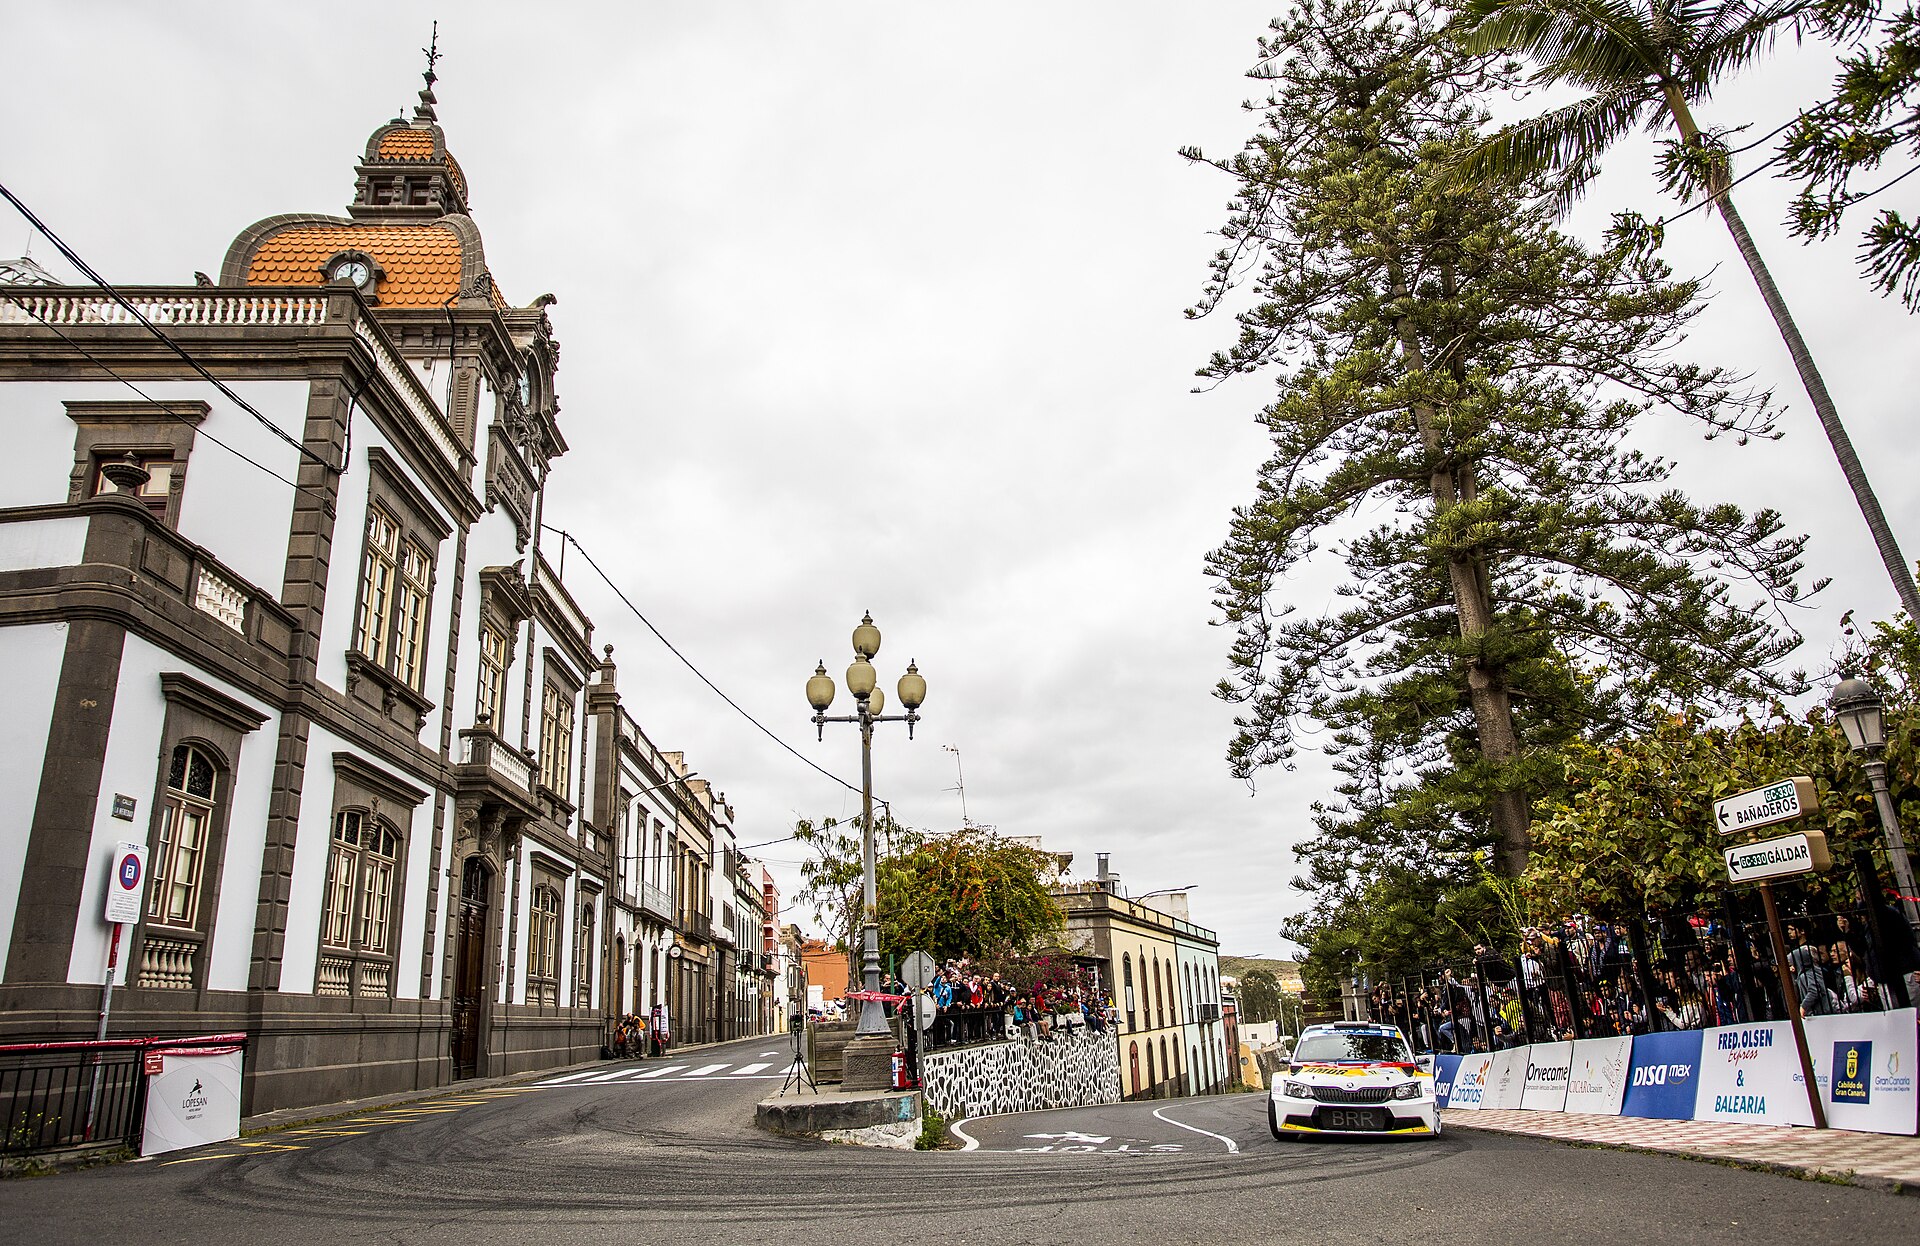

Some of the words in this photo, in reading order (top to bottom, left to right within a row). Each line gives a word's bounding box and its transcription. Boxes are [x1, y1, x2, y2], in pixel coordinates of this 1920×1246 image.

[1765, 784, 1793, 801] GC-330
[1736, 797, 1798, 823] BAÑADEROS
[1740, 855, 1767, 868] GC-330
[1767, 845, 1809, 864] GÁLDAR
[1728, 1049, 1758, 1066] Express
[1463, 1071, 1477, 1086] Islas
[1527, 1063, 1568, 1081] Orvecame
[1668, 1064, 1692, 1077] max
[1835, 1088, 1847, 1096] Gran
[1847, 1088, 1866, 1097] Canaria
[1837, 1081, 1856, 1089] Cabildo
[1451, 1085, 1482, 1103] Canarias
[182, 1097, 208, 1109] LOPESAN
[1715, 1095, 1766, 1115] BALEARIA
[1332, 1111, 1374, 1127] BRR
